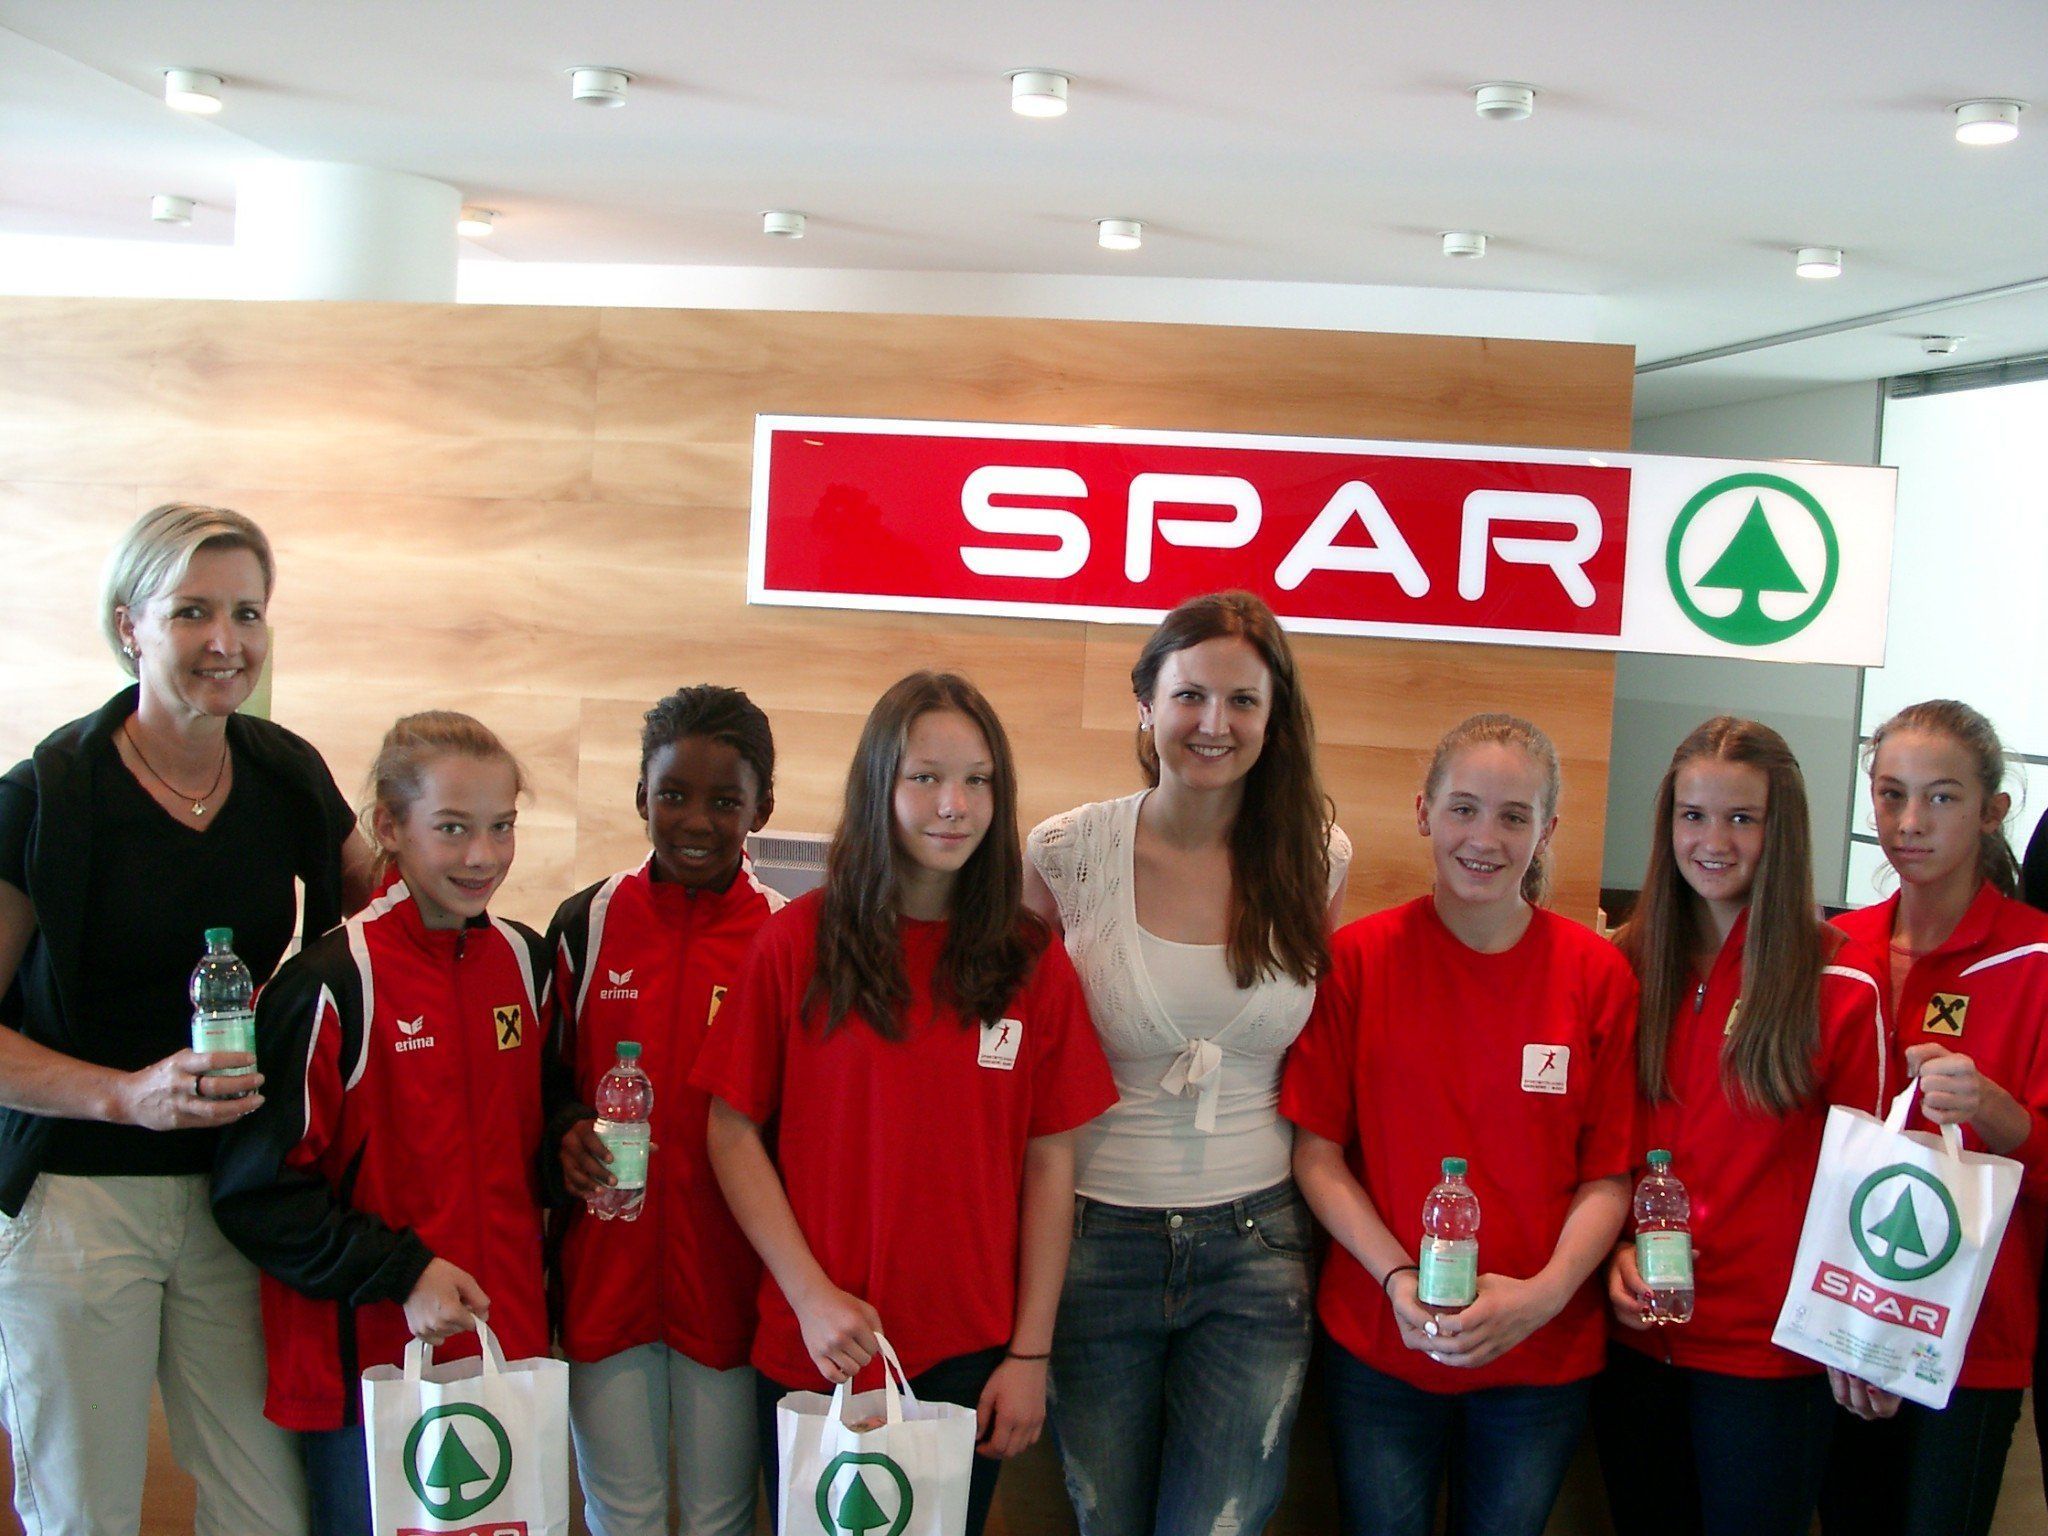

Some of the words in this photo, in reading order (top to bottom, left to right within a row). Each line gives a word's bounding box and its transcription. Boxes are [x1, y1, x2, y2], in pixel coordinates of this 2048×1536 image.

[960, 465, 1602, 608] SPAR
[600, 986, 638, 1000] erima
[395, 1036, 434, 1052] erima
[1820, 1270, 1940, 1331] SPAR
